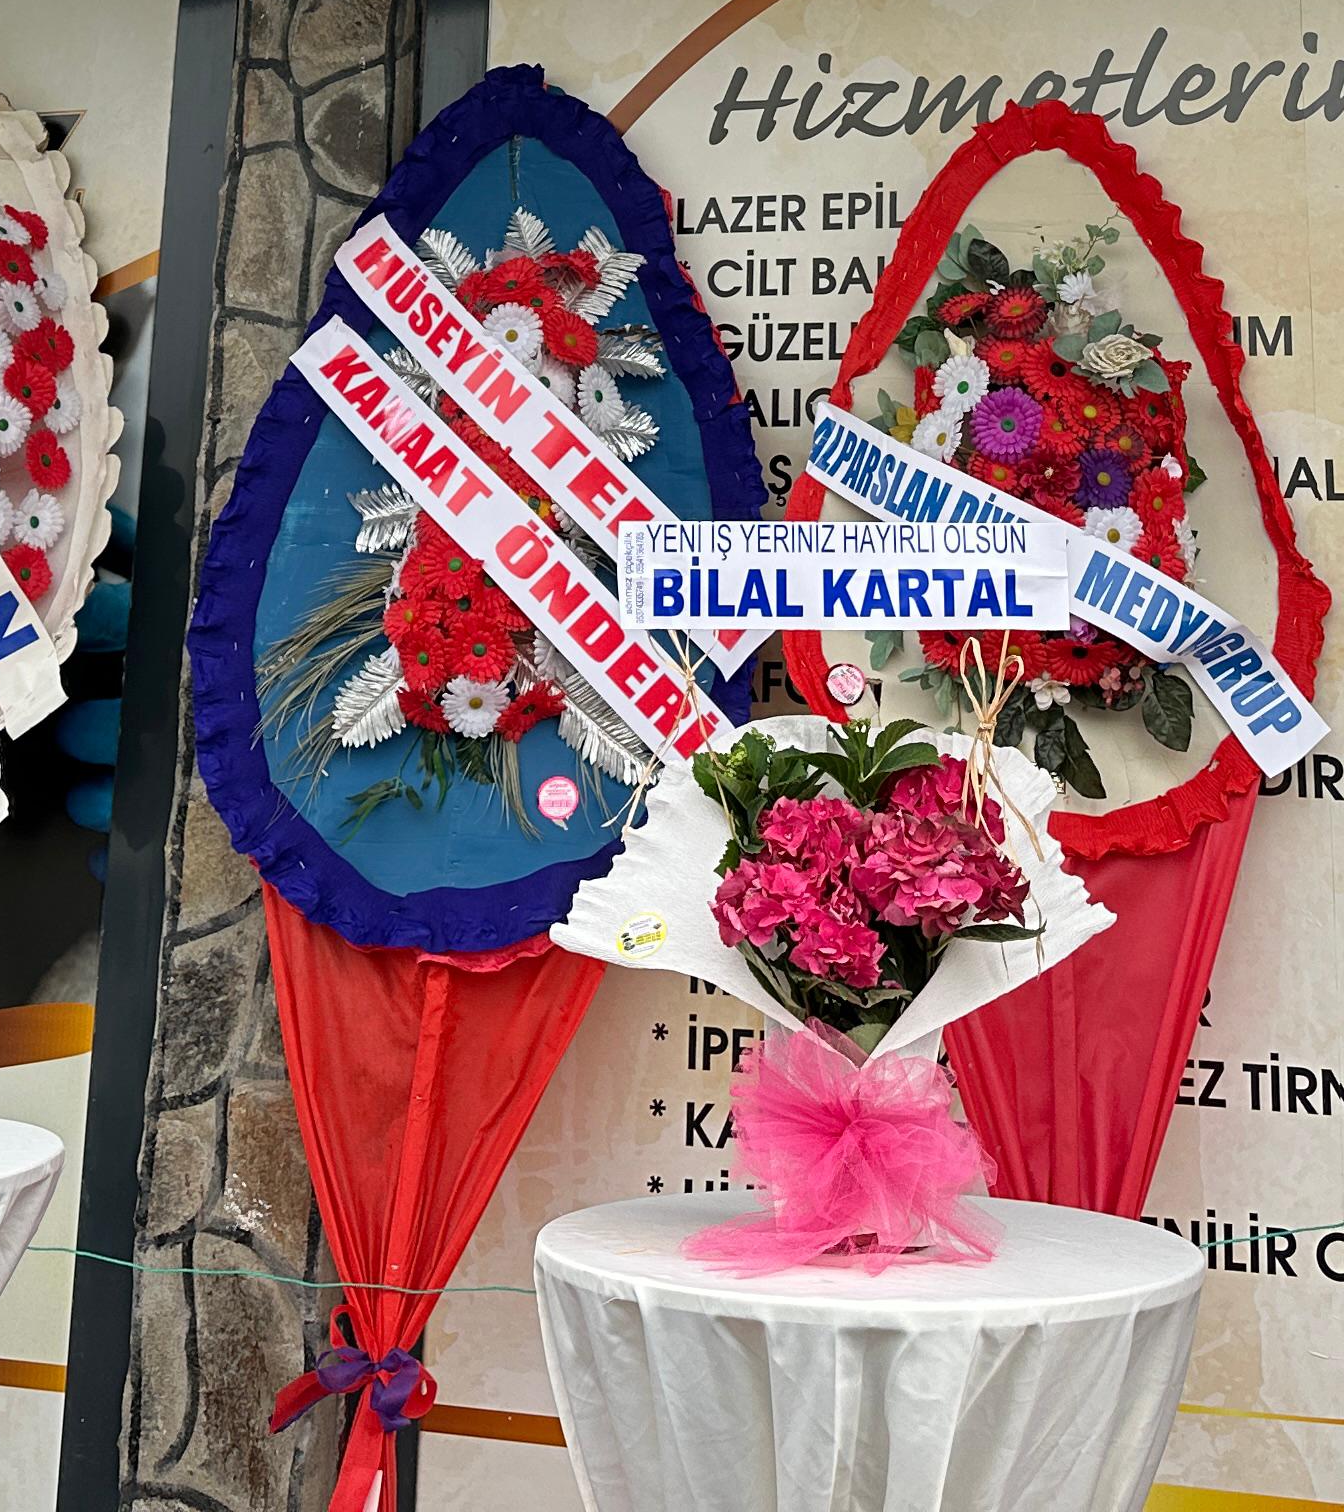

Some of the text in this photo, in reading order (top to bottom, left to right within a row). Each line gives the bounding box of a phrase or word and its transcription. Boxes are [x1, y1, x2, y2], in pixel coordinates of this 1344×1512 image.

[675, 181, 908, 235] LAZER EPİL
[707, 248, 797, 298] CİLT
[353, 236, 532, 424] HÜSEYİN
[713, 312, 859, 362] GÜZEL
[318, 344, 493, 518] KANAAT
[843, 524, 935, 553] HAYIRLI
[943, 524, 1026, 553] OLSUN
[655, 555, 1034, 618] BİLAL KARTAL
